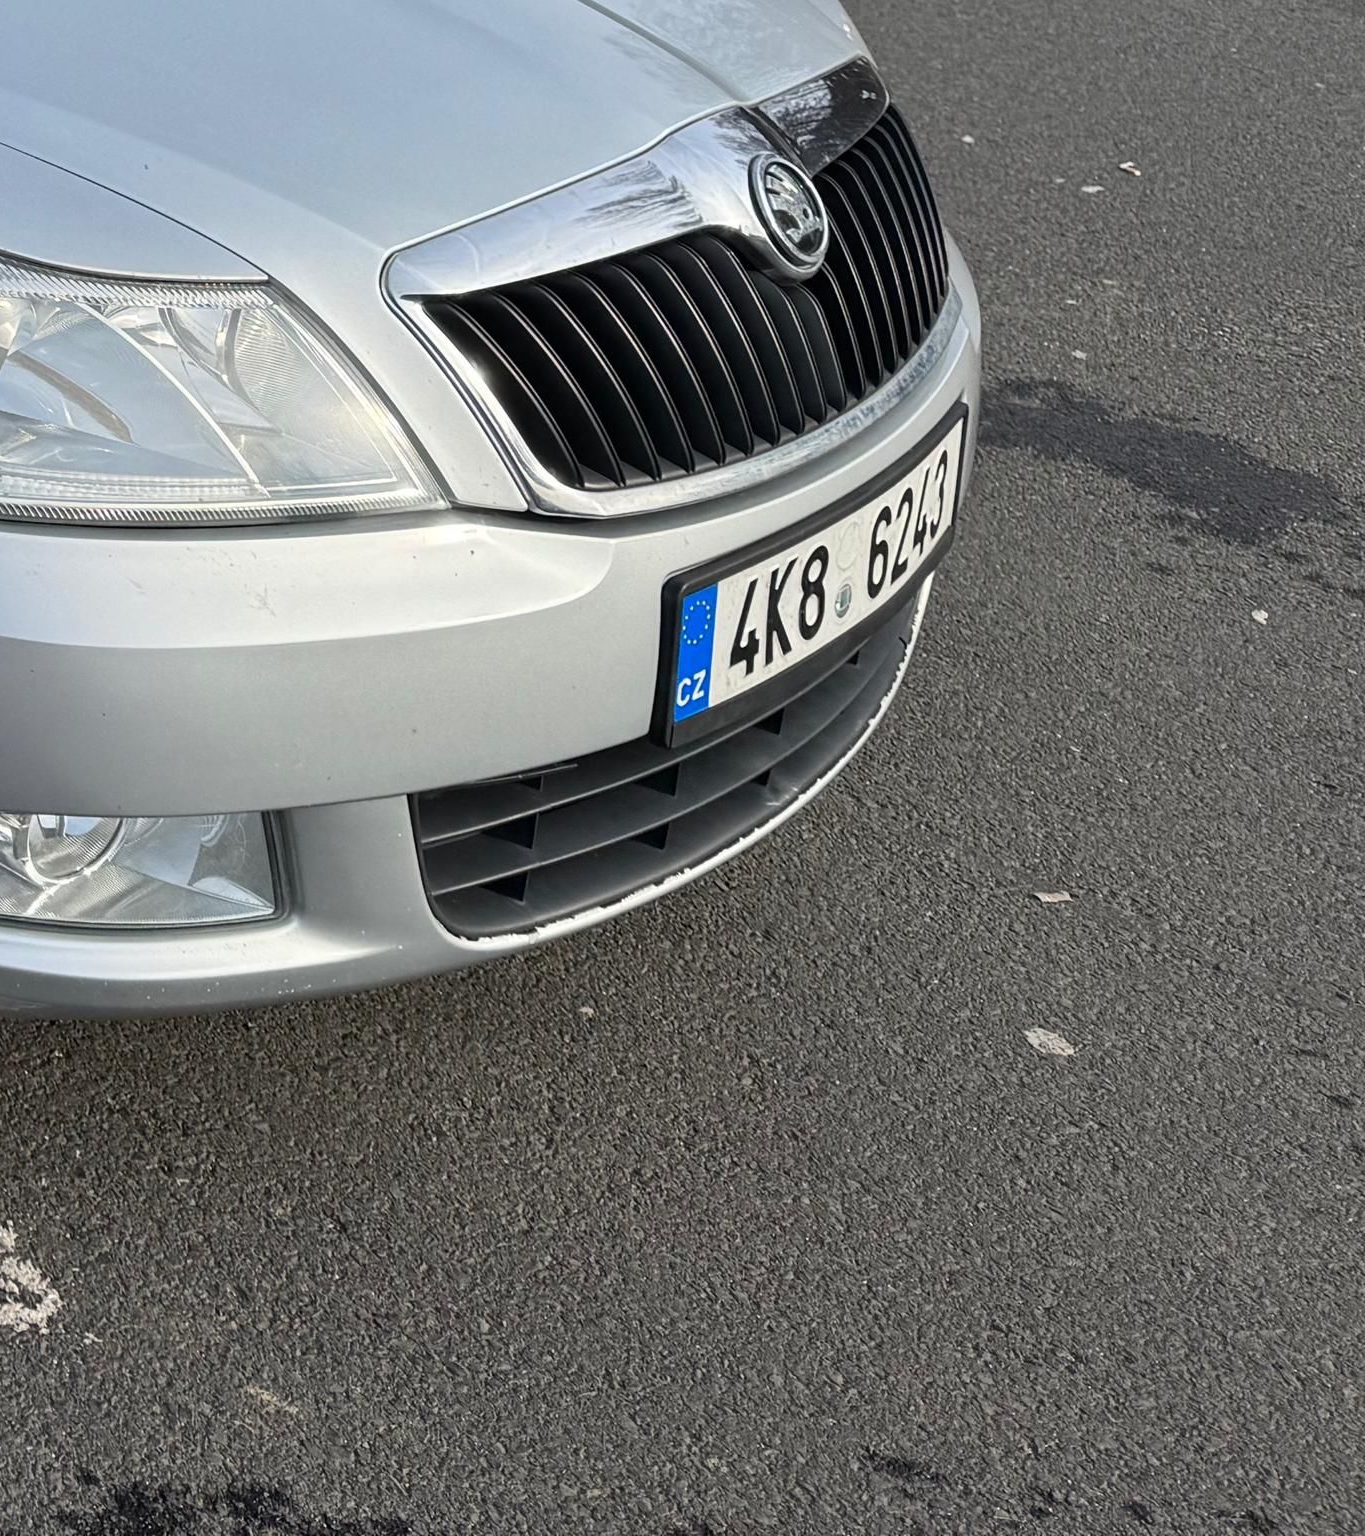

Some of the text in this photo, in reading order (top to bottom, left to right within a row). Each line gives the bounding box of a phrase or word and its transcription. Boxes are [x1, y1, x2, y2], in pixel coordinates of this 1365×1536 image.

[729, 449, 949, 677] 4K8 6243
[676, 668, 706, 707] CZ
